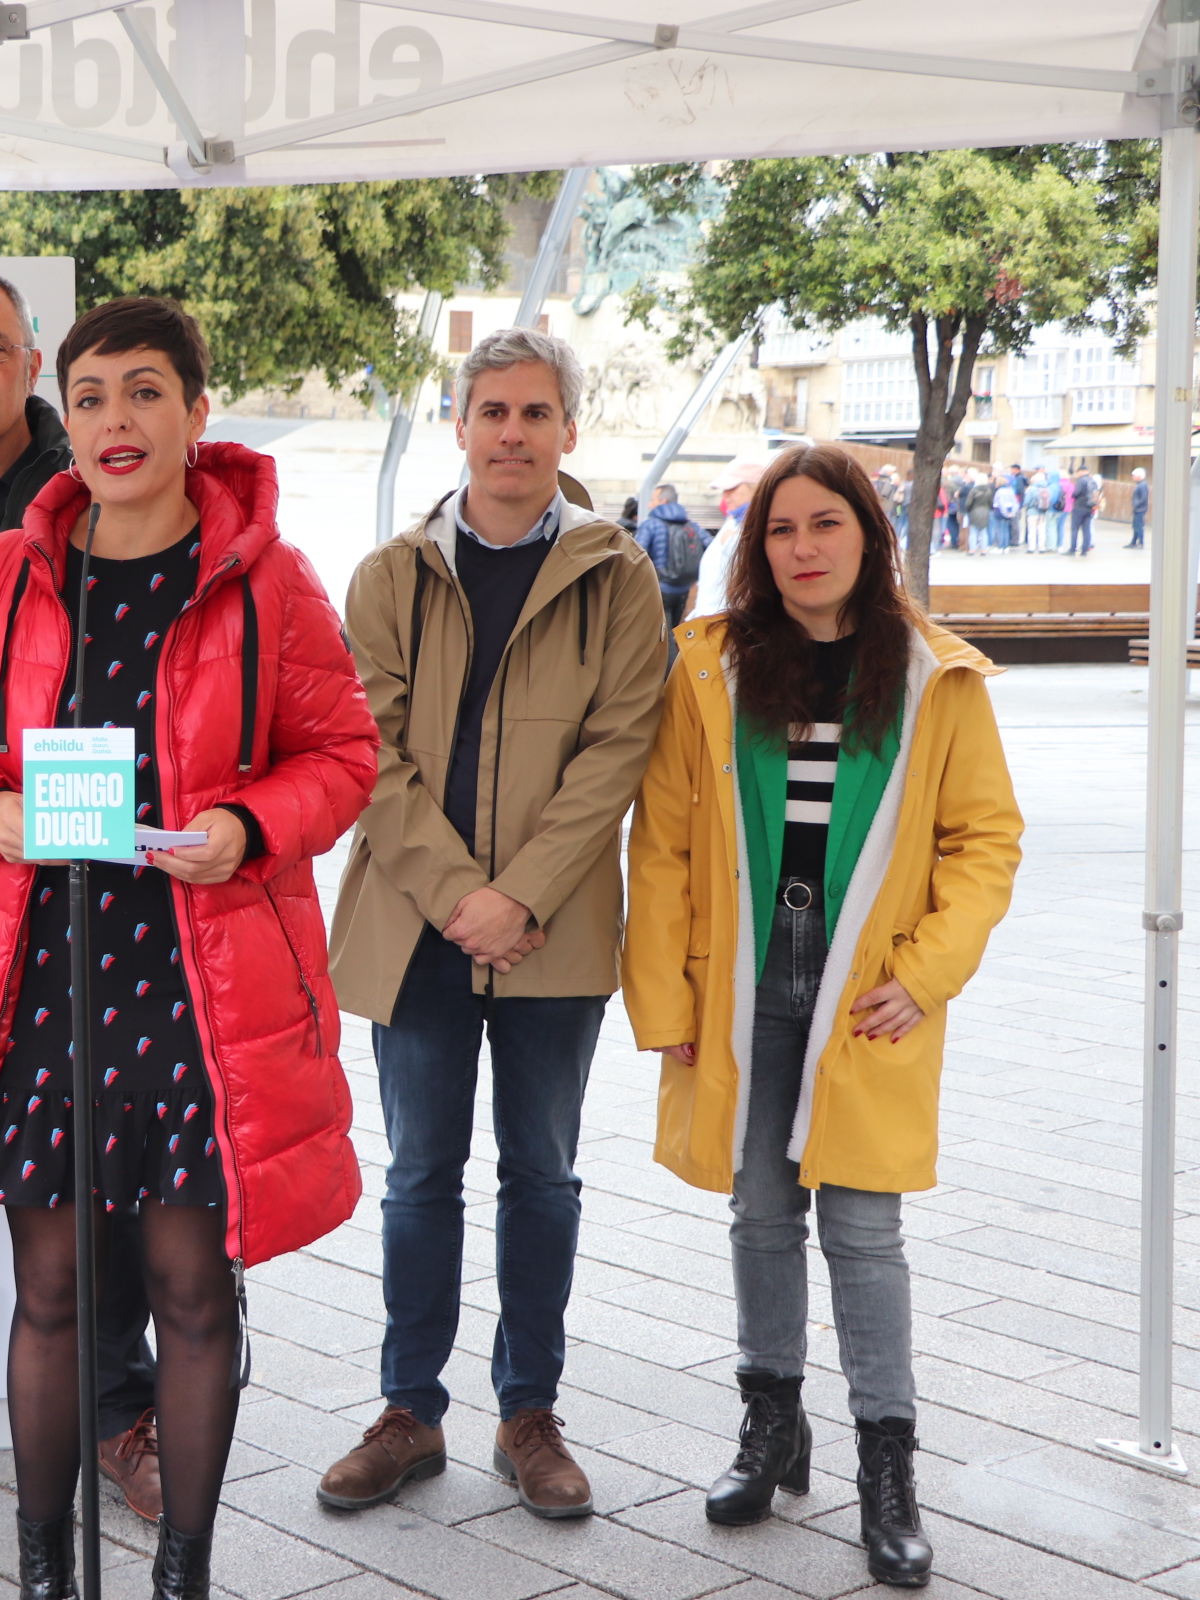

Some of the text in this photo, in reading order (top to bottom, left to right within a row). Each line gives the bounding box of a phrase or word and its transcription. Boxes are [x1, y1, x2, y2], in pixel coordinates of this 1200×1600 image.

[33, 739, 84, 752] ehbildu
[35, 772, 124, 808] EGINGO
[35, 811, 109, 847] DUGU.
